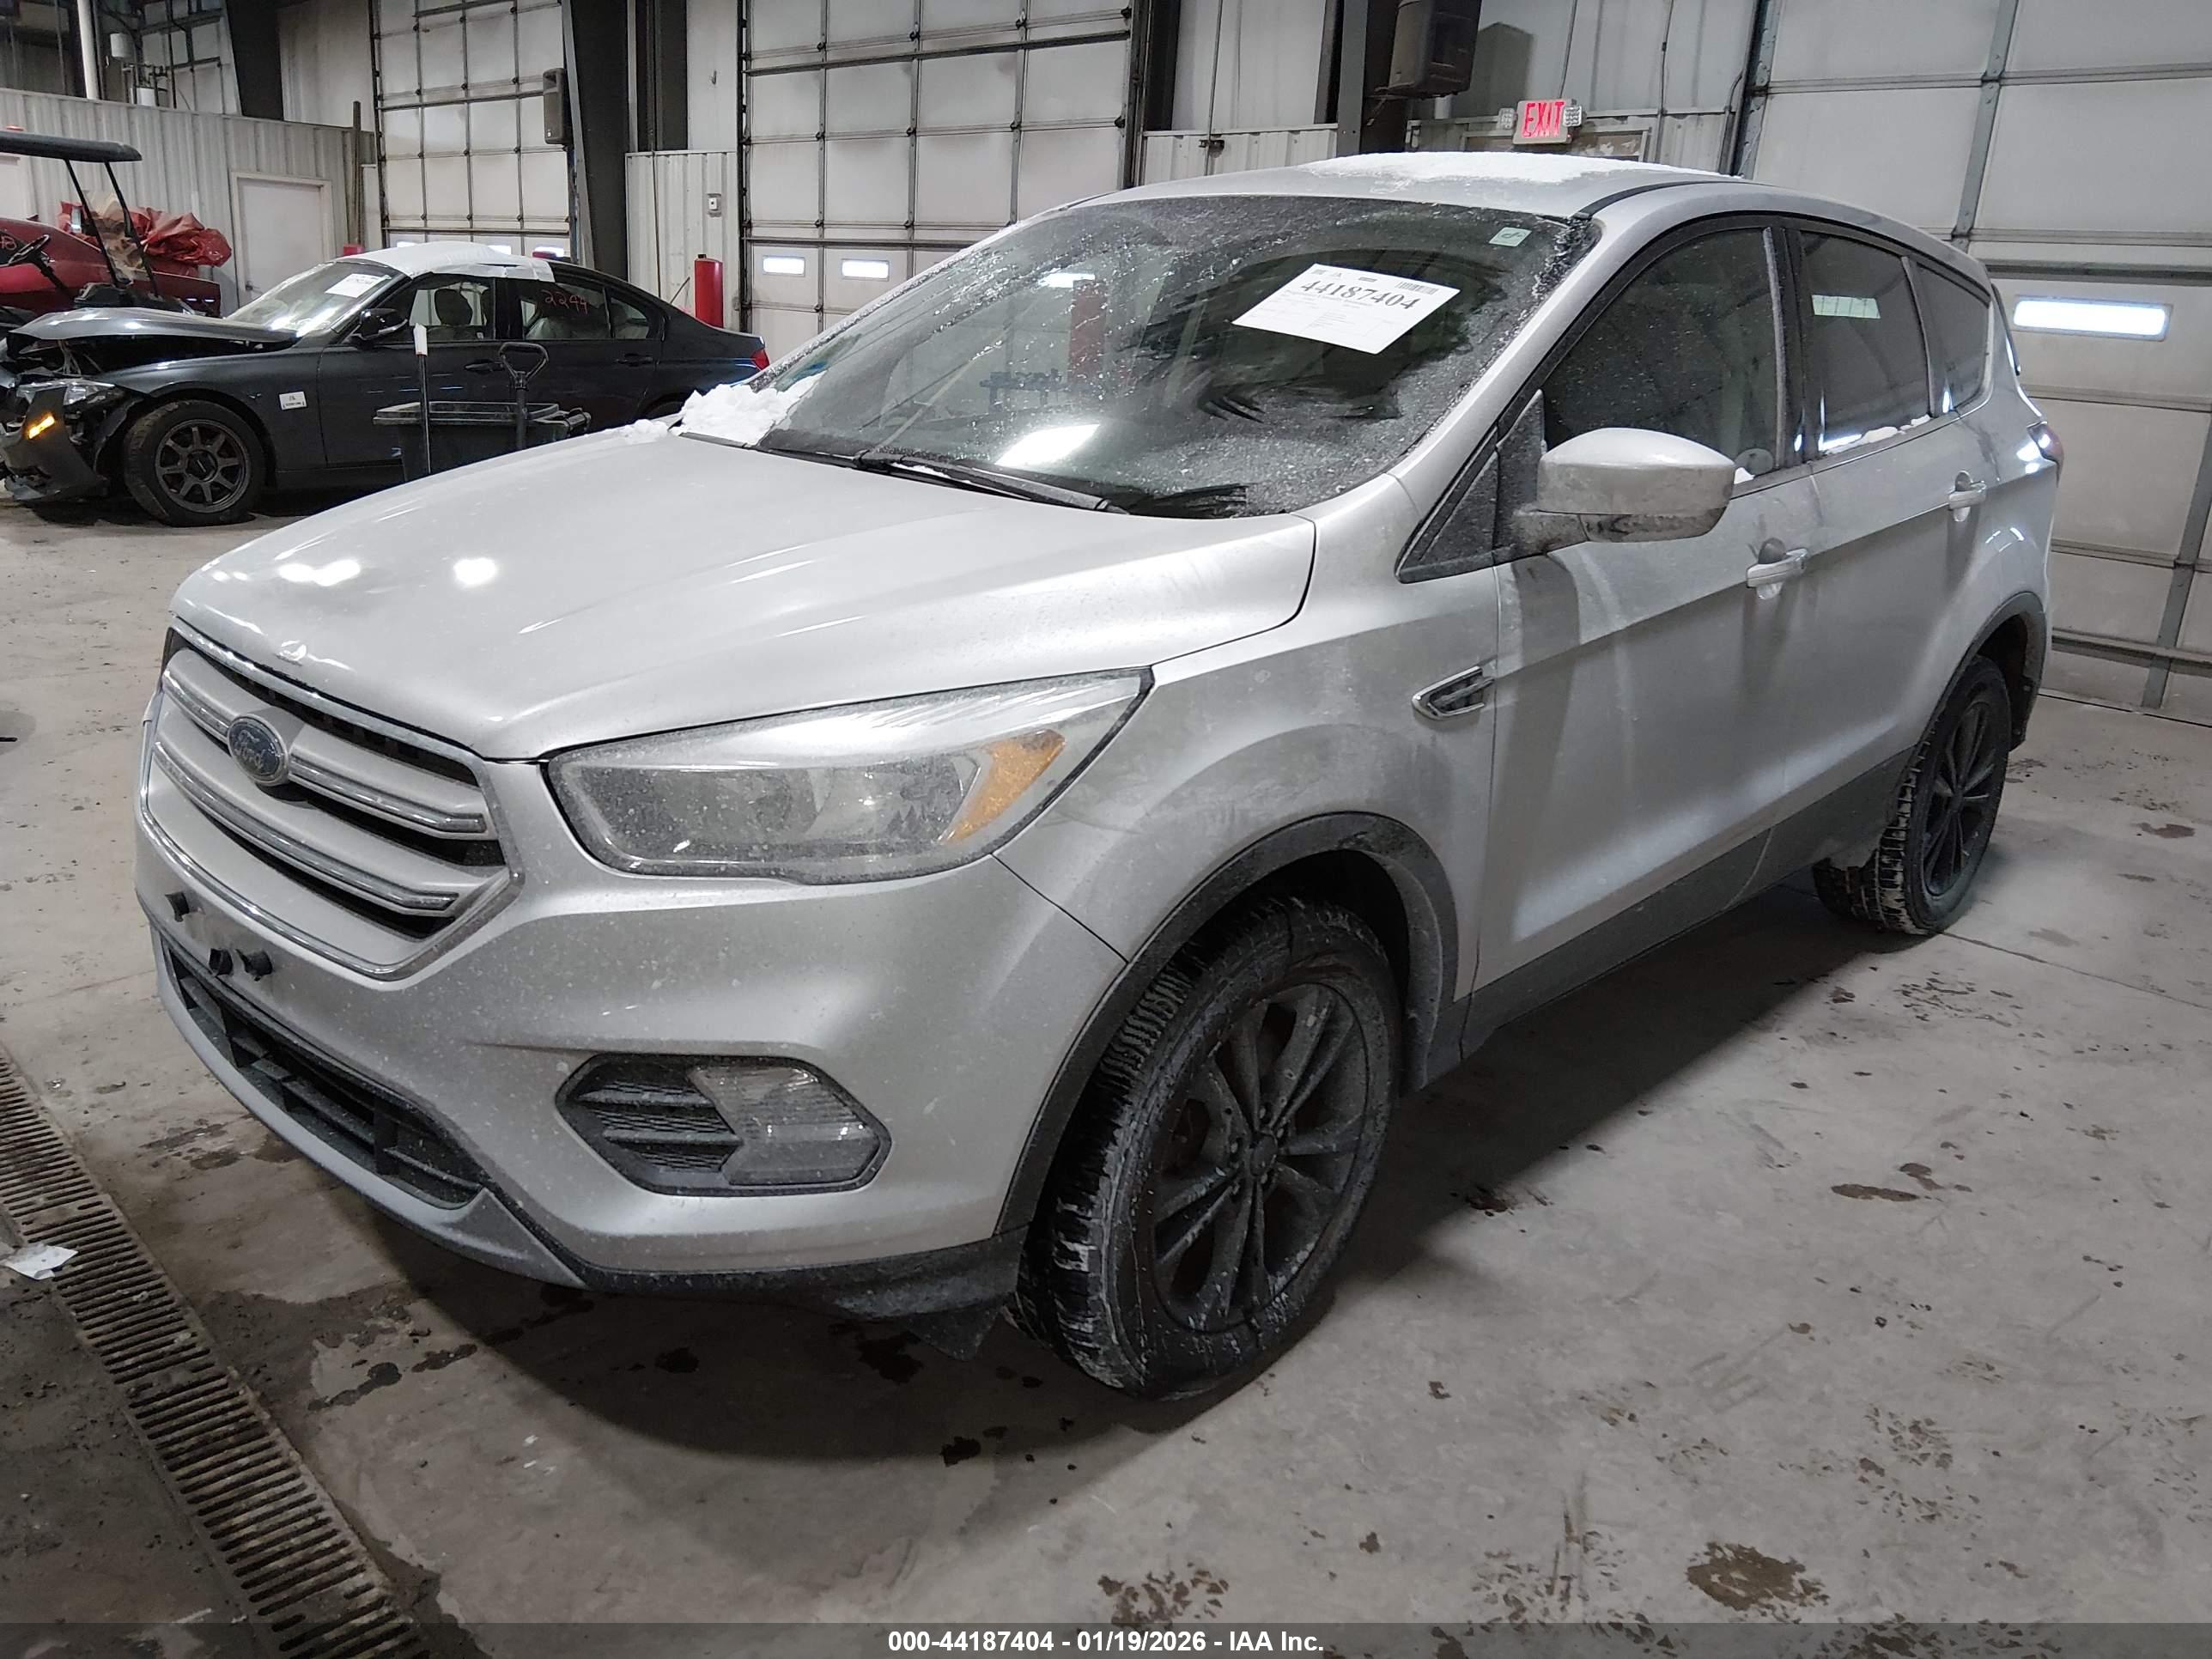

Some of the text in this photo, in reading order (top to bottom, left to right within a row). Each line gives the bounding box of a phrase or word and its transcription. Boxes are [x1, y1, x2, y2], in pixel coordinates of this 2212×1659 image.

[1522, 101, 1565, 137] EXIT
[1299, 279, 1422, 310] 44187404
[234, 729, 266, 770] Ford
